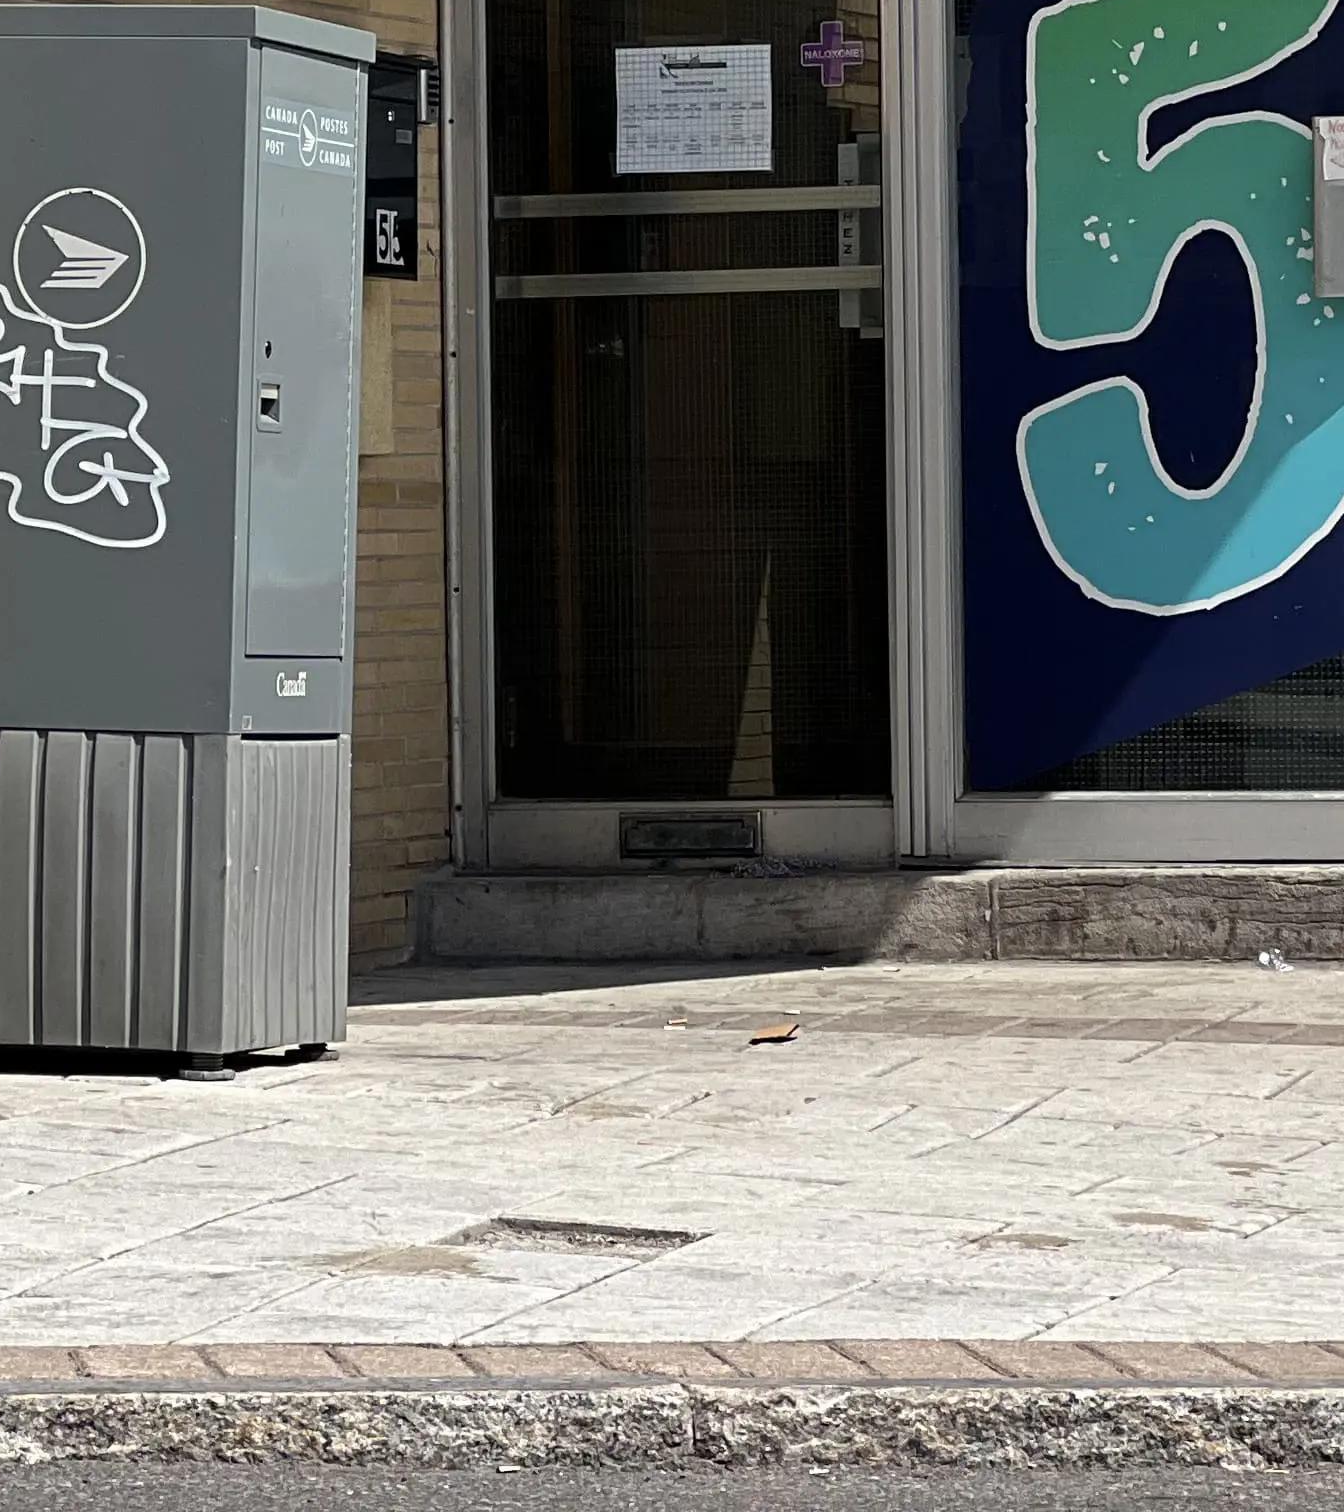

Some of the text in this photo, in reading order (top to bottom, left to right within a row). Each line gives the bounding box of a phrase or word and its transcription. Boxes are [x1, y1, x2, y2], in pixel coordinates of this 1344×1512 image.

[265, 105, 298, 125] CANADA
[320, 116, 348, 135] POSTES
[265, 139, 285, 156] POST
[319, 149, 351, 168] CANADA
[276, 672, 306, 697] Canada
